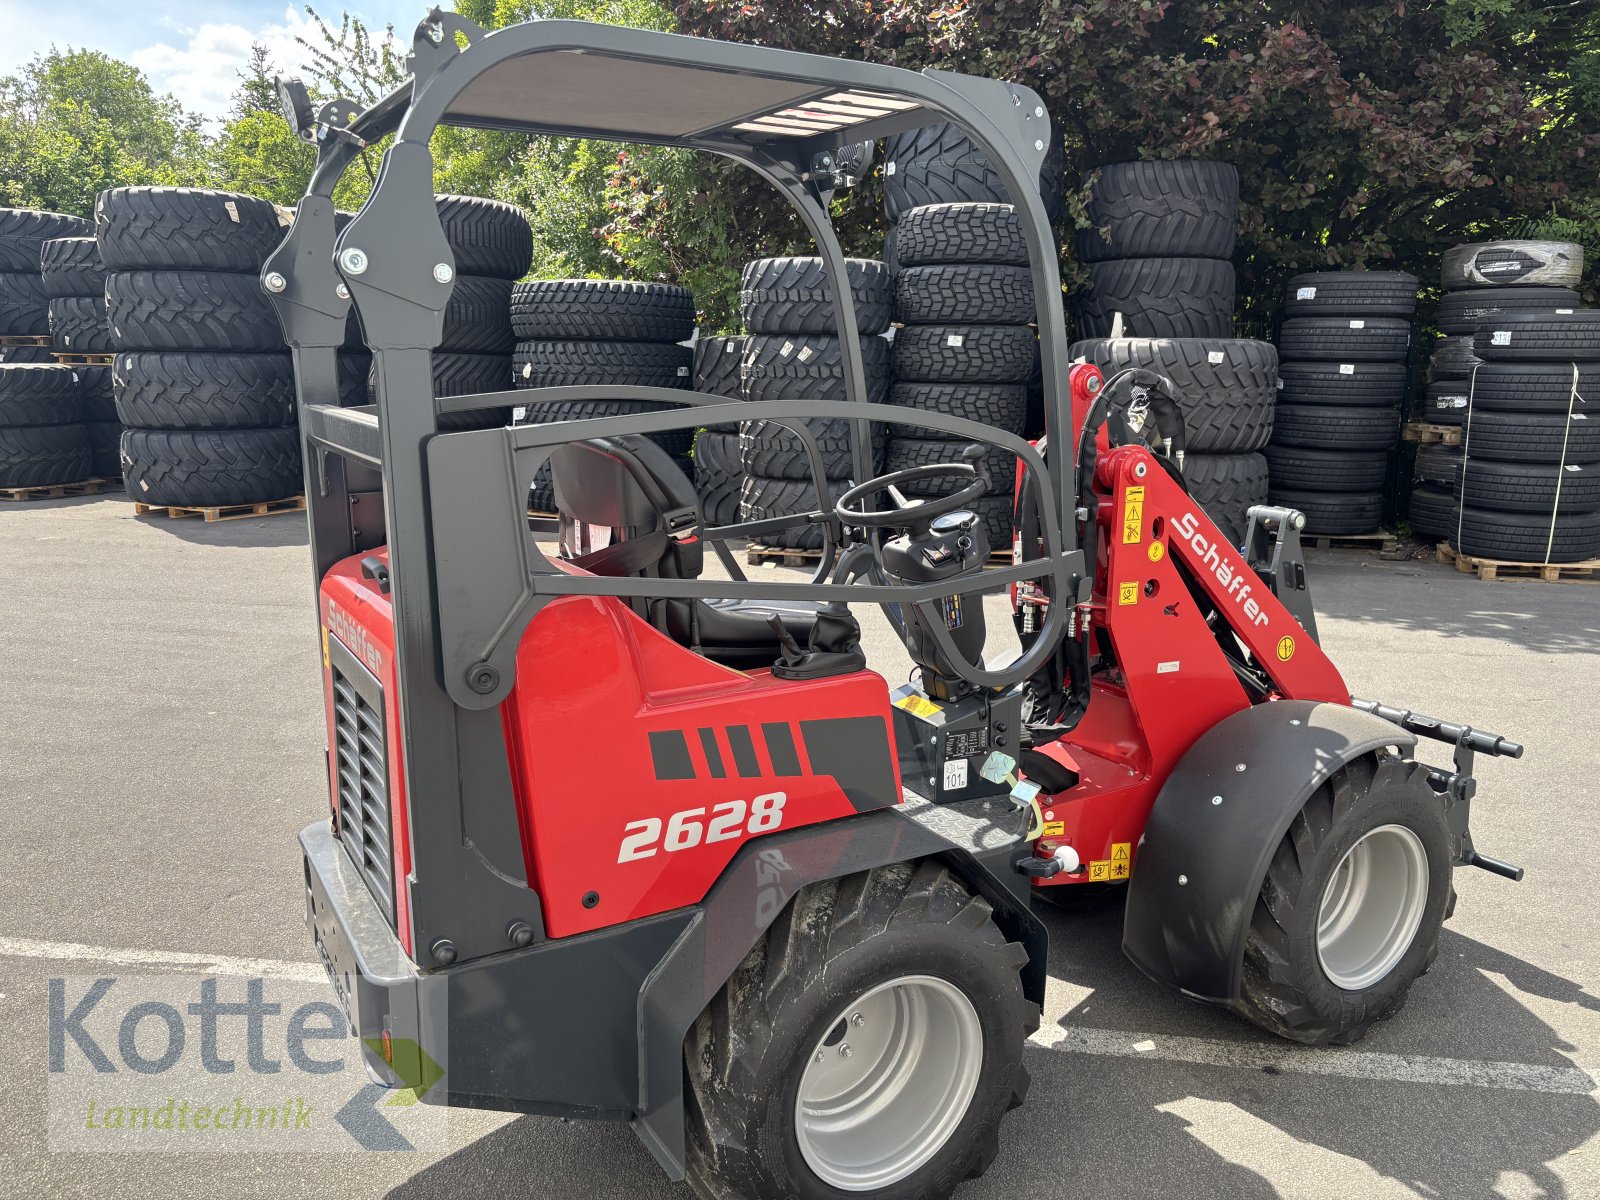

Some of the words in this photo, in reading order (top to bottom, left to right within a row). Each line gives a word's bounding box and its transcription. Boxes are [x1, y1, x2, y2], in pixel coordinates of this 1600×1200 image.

[1171, 512, 1269, 627] Schäffer
[328, 598, 382, 675] Schäffer
[947, 773, 961, 788] 101
[617, 791, 787, 864] 2628
